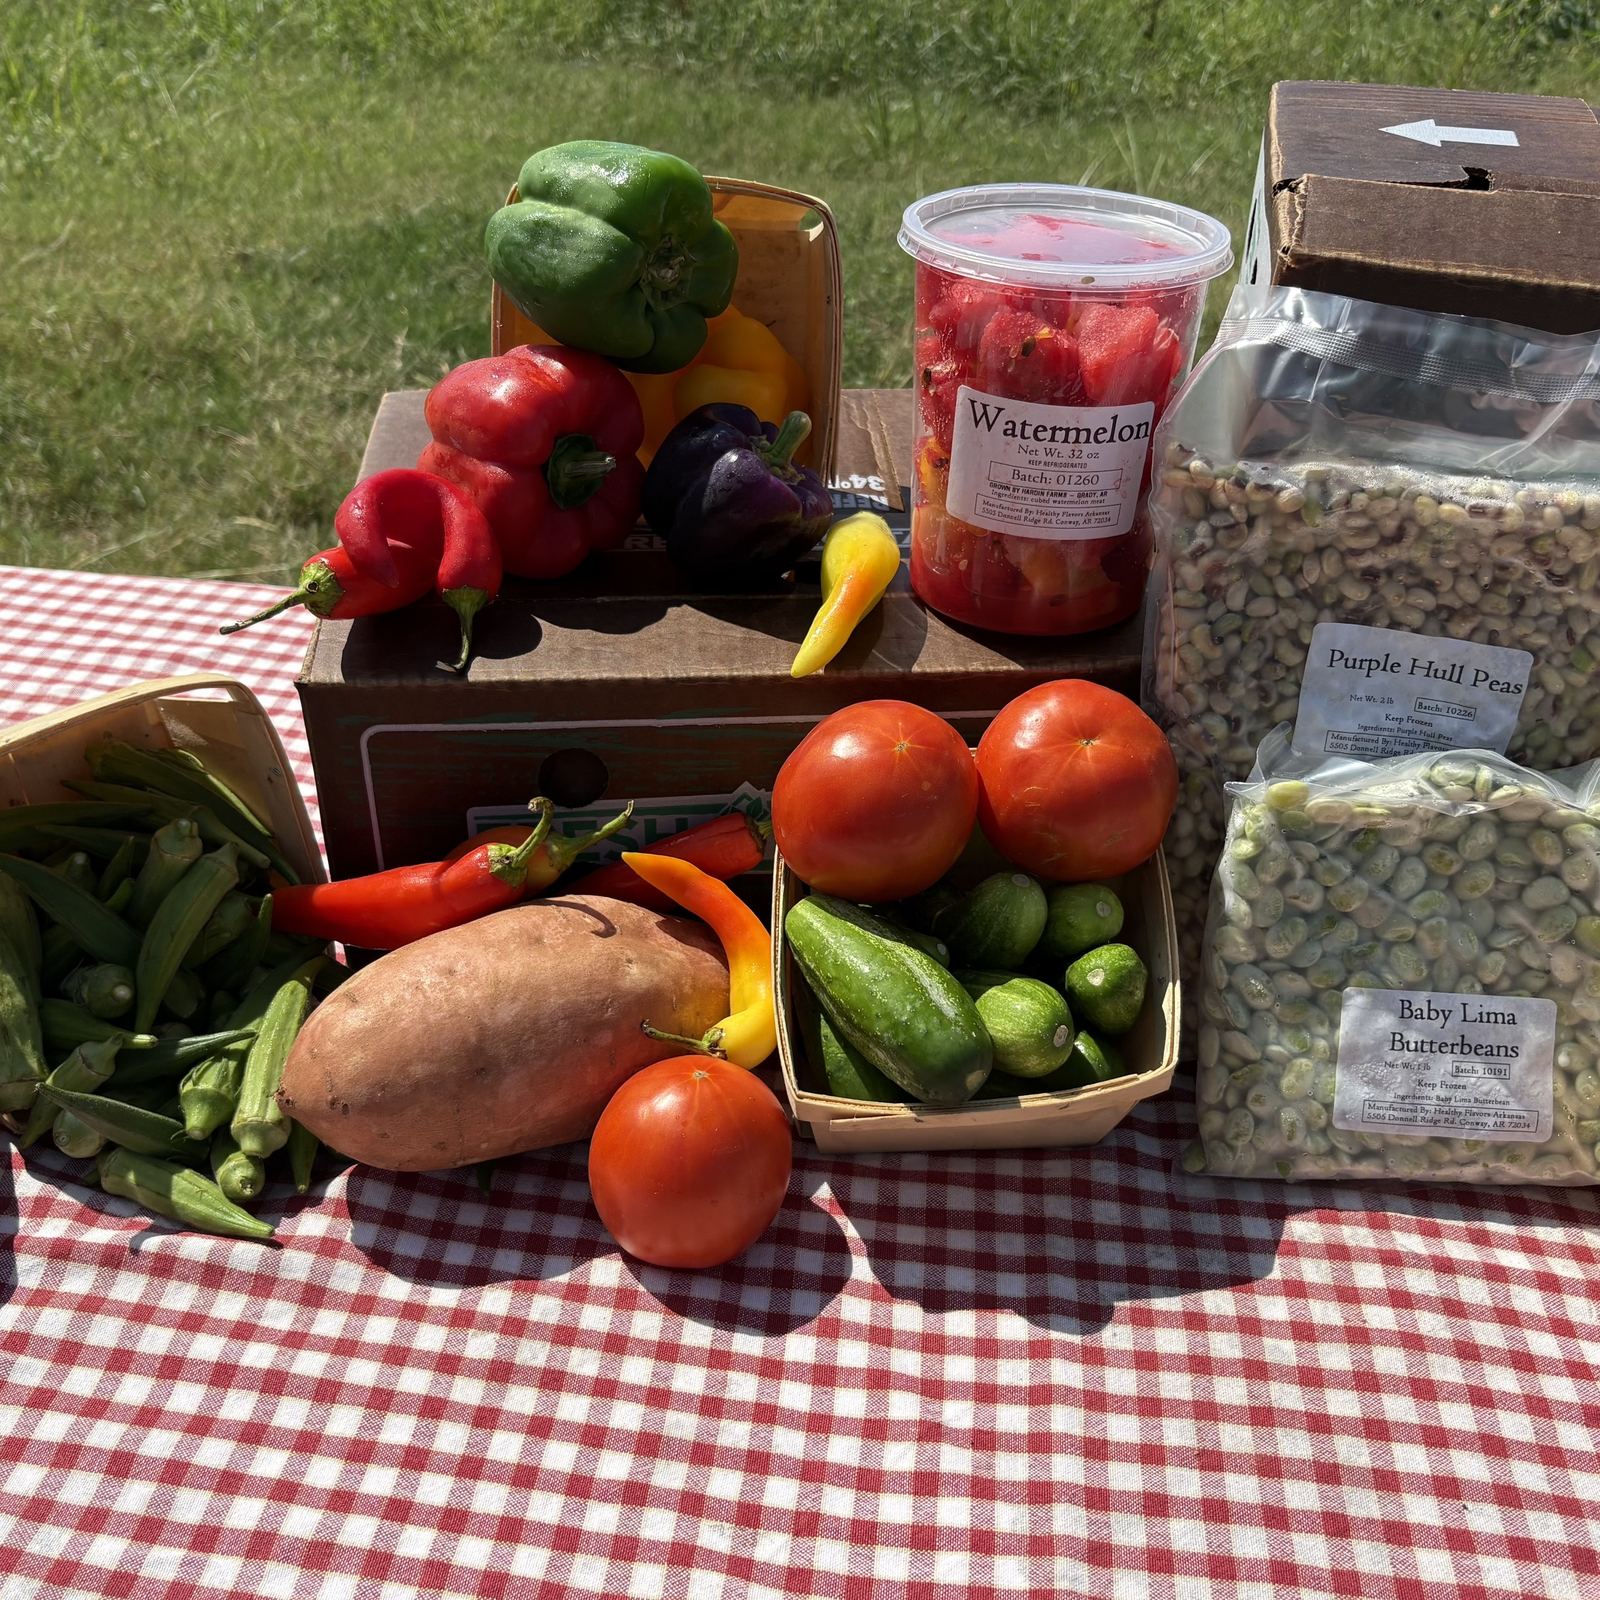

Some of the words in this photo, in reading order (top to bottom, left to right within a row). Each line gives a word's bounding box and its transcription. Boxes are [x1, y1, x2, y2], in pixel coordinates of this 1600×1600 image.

[968, 398, 1149, 444] Watermelon
[1018, 444, 1039, 456] Net
[1044, 448, 1064, 458] Wt.
[1069, 449, 1082, 459] 32
[1012, 469, 1052, 484] Batch:
[1057, 475, 1099, 485] 01260
[989, 482, 1010, 492] GROWN
[1022, 489, 1044, 497] HARDIN
[991, 489, 1029, 502] Ingredients:
[982, 500, 1023, 513] Manufactured
[1024, 507, 1034, 515] By:
[1036, 509, 1060, 517] Healthy
[1024, 515, 1041, 524] Ridge
[1056, 518, 1081, 526] Conway,
[1327, 649, 1401, 678] Purple
[1408, 658, 1464, 684] Hull
[1470, 668, 1524, 695] Peas
[1350, 694, 1362, 702] Net
[1365, 695, 1378, 703] Wt.
[1417, 702, 1442, 712] Batch:
[1446, 705, 1473, 718] 10226
[1385, 713, 1404, 724] Keep
[1406, 716, 1433, 727] Frozen
[1358, 723, 1395, 733] Ingredients:
[1396, 727, 1417, 736] Purple
[1419, 729, 1436, 738] Hull
[1438, 733, 1453, 742] Peas
[1331, 733, 1379, 744] Manufactured
[1381, 738, 1392, 746] By:
[1394, 739, 1422, 749] Healthy
[1329, 742, 1348, 750] 5505
[1350, 744, 1379, 754] Donnell
[1380, 747, 1402, 756] Ridge
[1398, 999, 1453, 1029] Baby
[1461, 1002, 1518, 1025] Lima
[1390, 1032, 1520, 1058] Butterbeans
[1384, 1061, 1399, 1069] Net
[1454, 1065, 1479, 1075] Batch:
[1482, 1067, 1508, 1076] 10191
[1417, 1079, 1438, 1090] Keep
[1440, 1080, 1467, 1090] Frozen
[1393, 1092, 1434, 1103] Ingredients:
[1435, 1095, 1452, 1105] Baby
[1454, 1096, 1472, 1105] Lima
[1473, 1097, 1510, 1106] Butterbean
[1367, 1103, 1418, 1114] Manufactured
[1420, 1106, 1432, 1115] By:
[1434, 1107, 1463, 1118] Healthy
[1465, 1109, 1491, 1118] Flavors
[1493, 1110, 1526, 1119] Arkansas
[1388, 1114, 1418, 1123] Donnell
[1420, 1116, 1441, 1126] Ridge
[1443, 1117, 1457, 1125] Rd.
[1459, 1118, 1491, 1128] Conway,
[1493, 1119, 1505, 1128] AR
[1508, 1121, 1531, 1129] 72034
